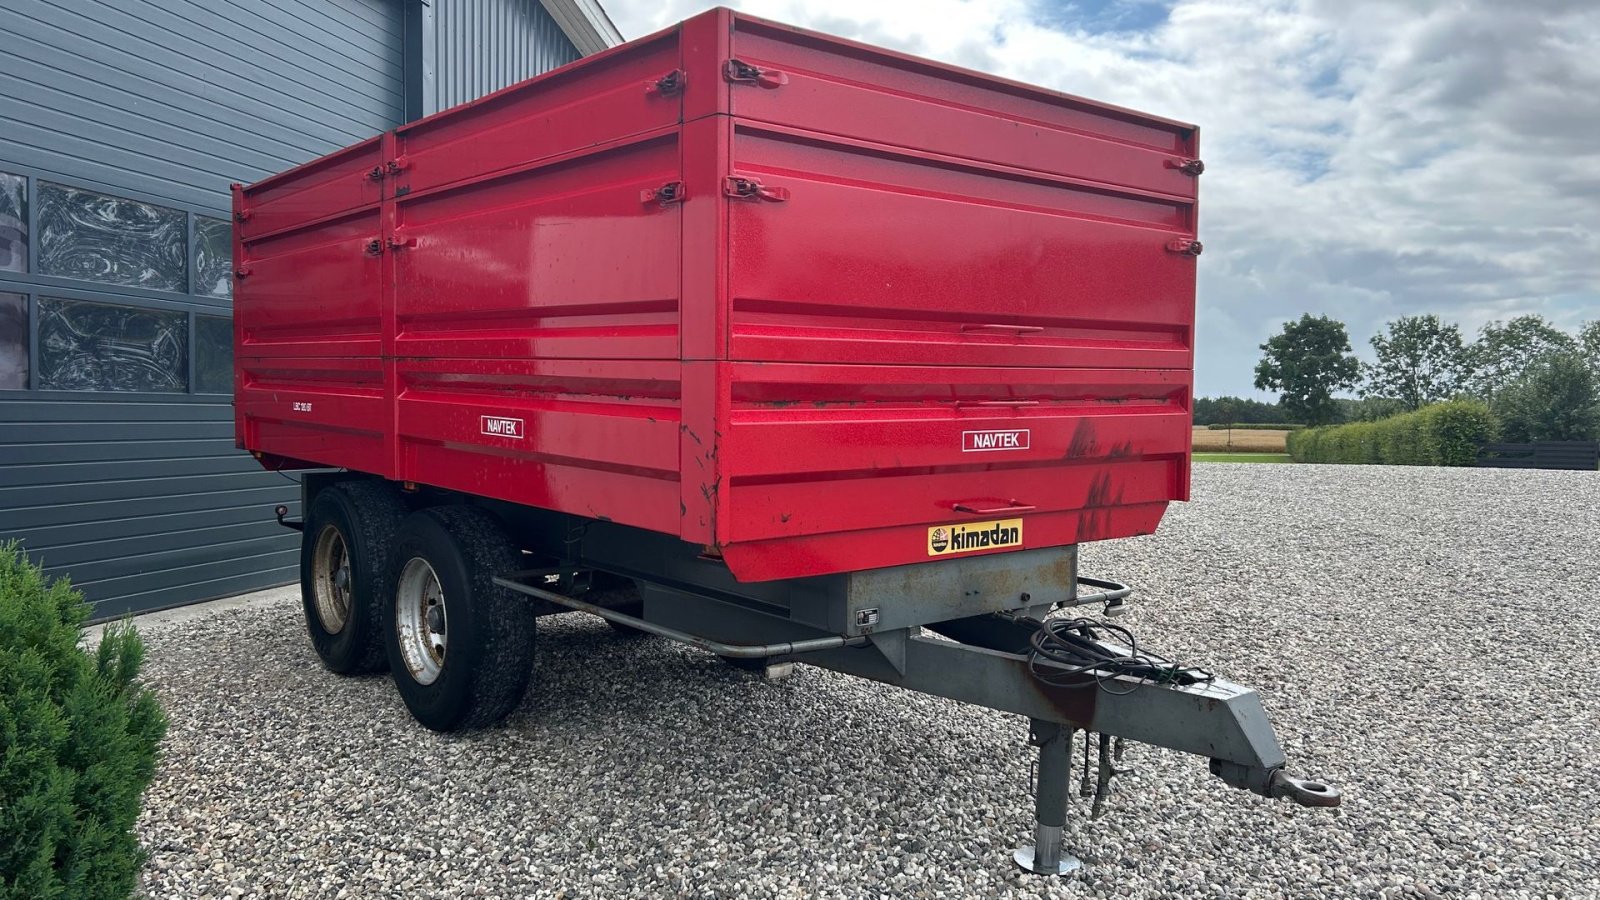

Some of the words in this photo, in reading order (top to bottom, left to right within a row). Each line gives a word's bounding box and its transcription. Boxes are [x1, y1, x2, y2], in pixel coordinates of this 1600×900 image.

[487, 418, 517, 435] NAVTEK
[973, 432, 1020, 449] NAVTEK
[951, 522, 1019, 551] kimadan
